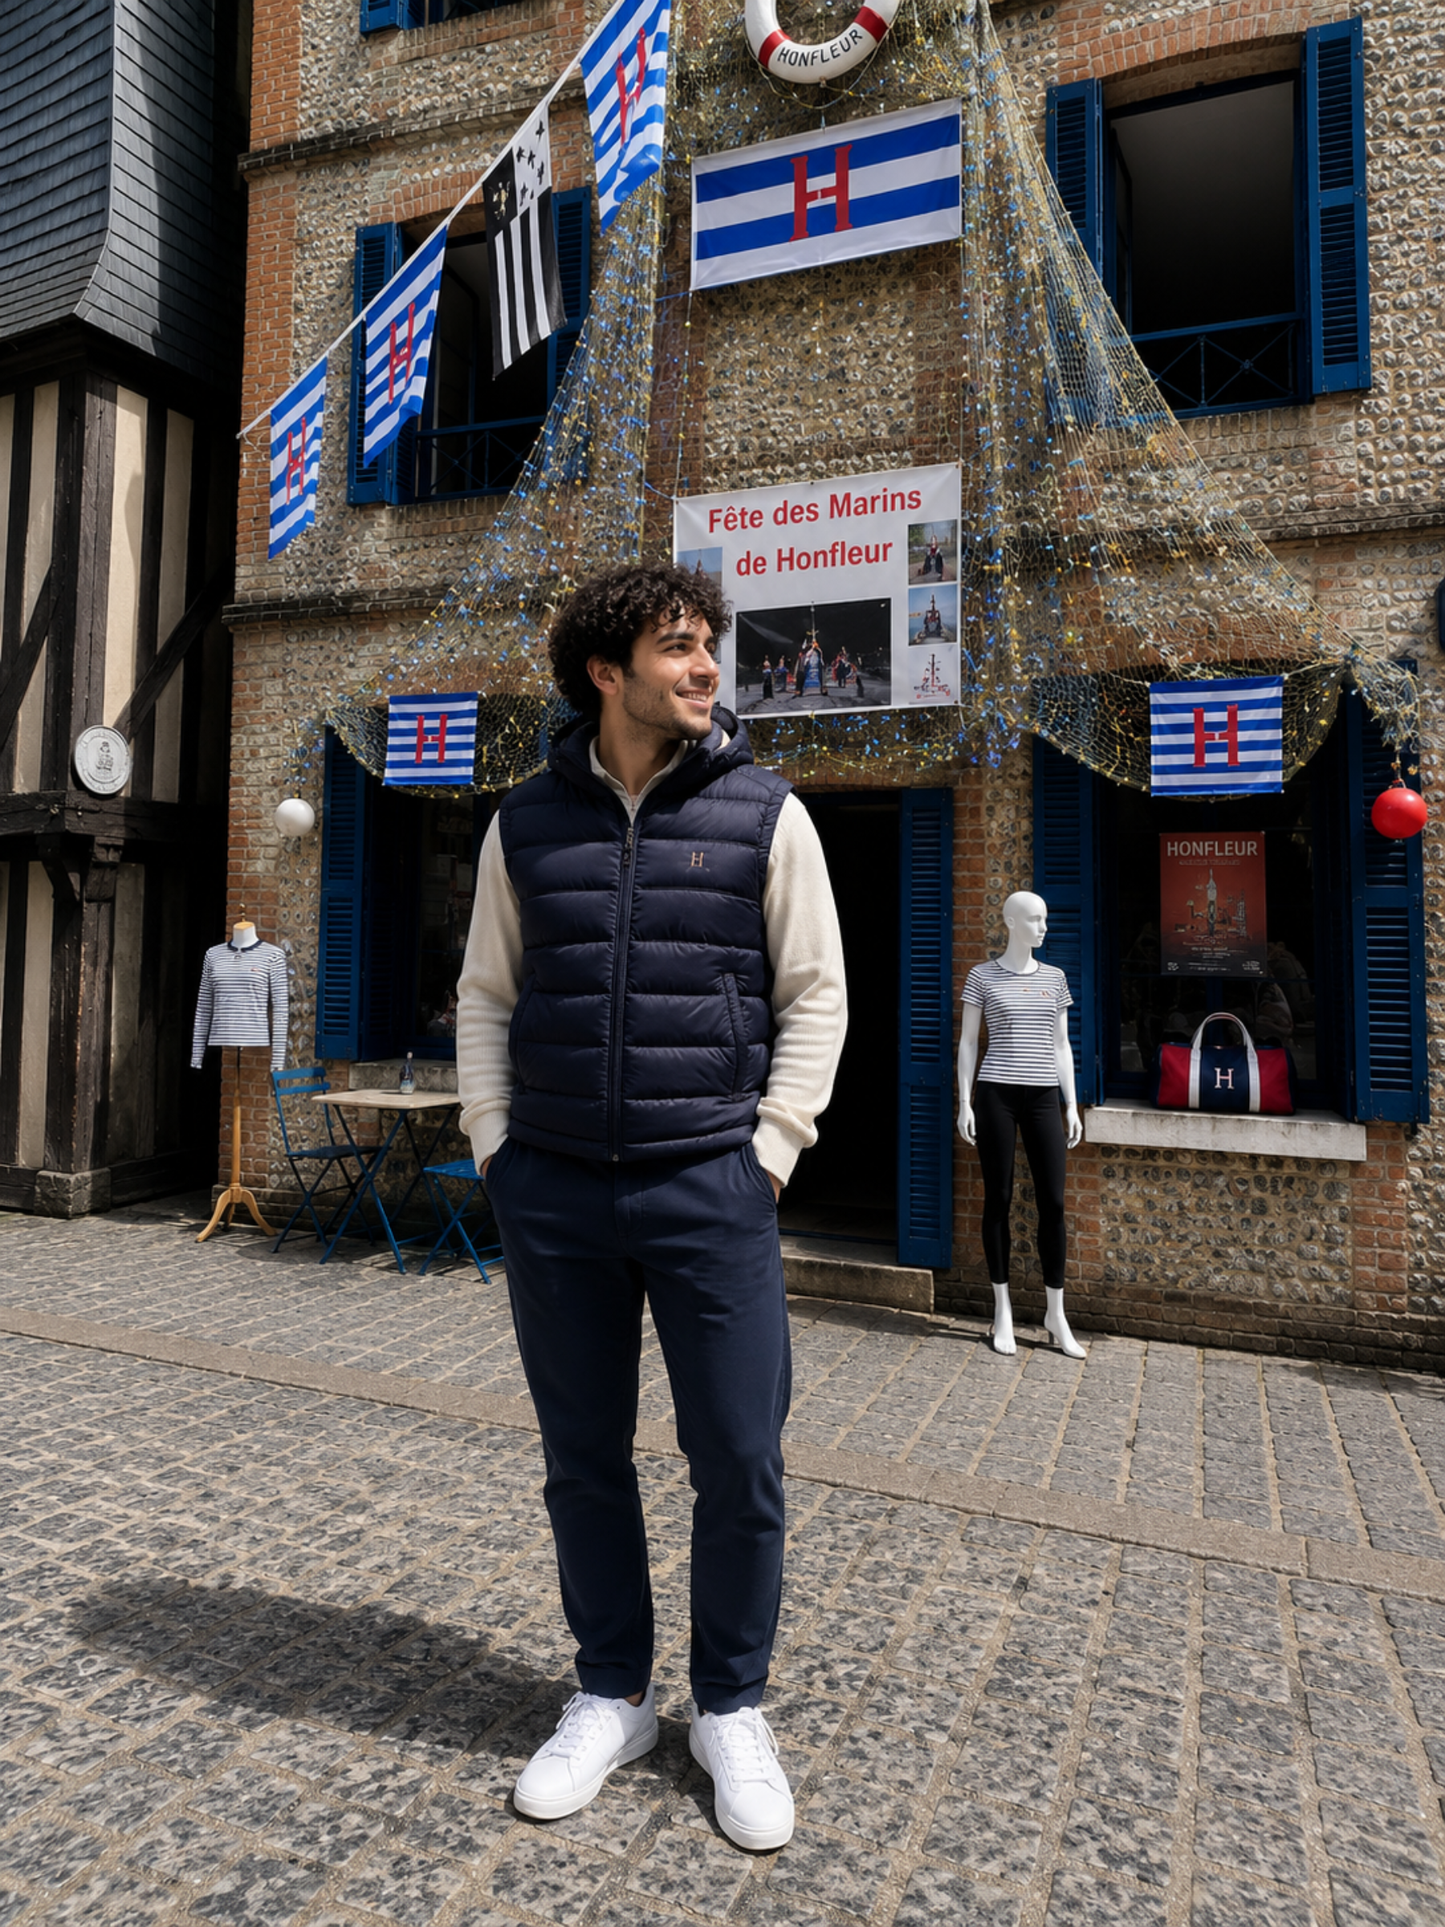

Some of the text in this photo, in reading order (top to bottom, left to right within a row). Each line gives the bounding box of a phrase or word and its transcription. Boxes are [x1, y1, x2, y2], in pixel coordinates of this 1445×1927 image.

[777, 28, 864, 67] HONFLEUR
[789, 144, 853, 242] H
[388, 302, 415, 404] H
[286, 416, 307, 505] H
[708, 487, 922, 533] Fête des Marins
[736, 540, 893, 576] de Honfleur
[415, 714, 448, 764] H
[1193, 704, 1239, 767] H
[691, 852, 704, 867] H
[1167, 841, 1258, 857] HONFLEUR
[1214, 1067, 1234, 1089] H
